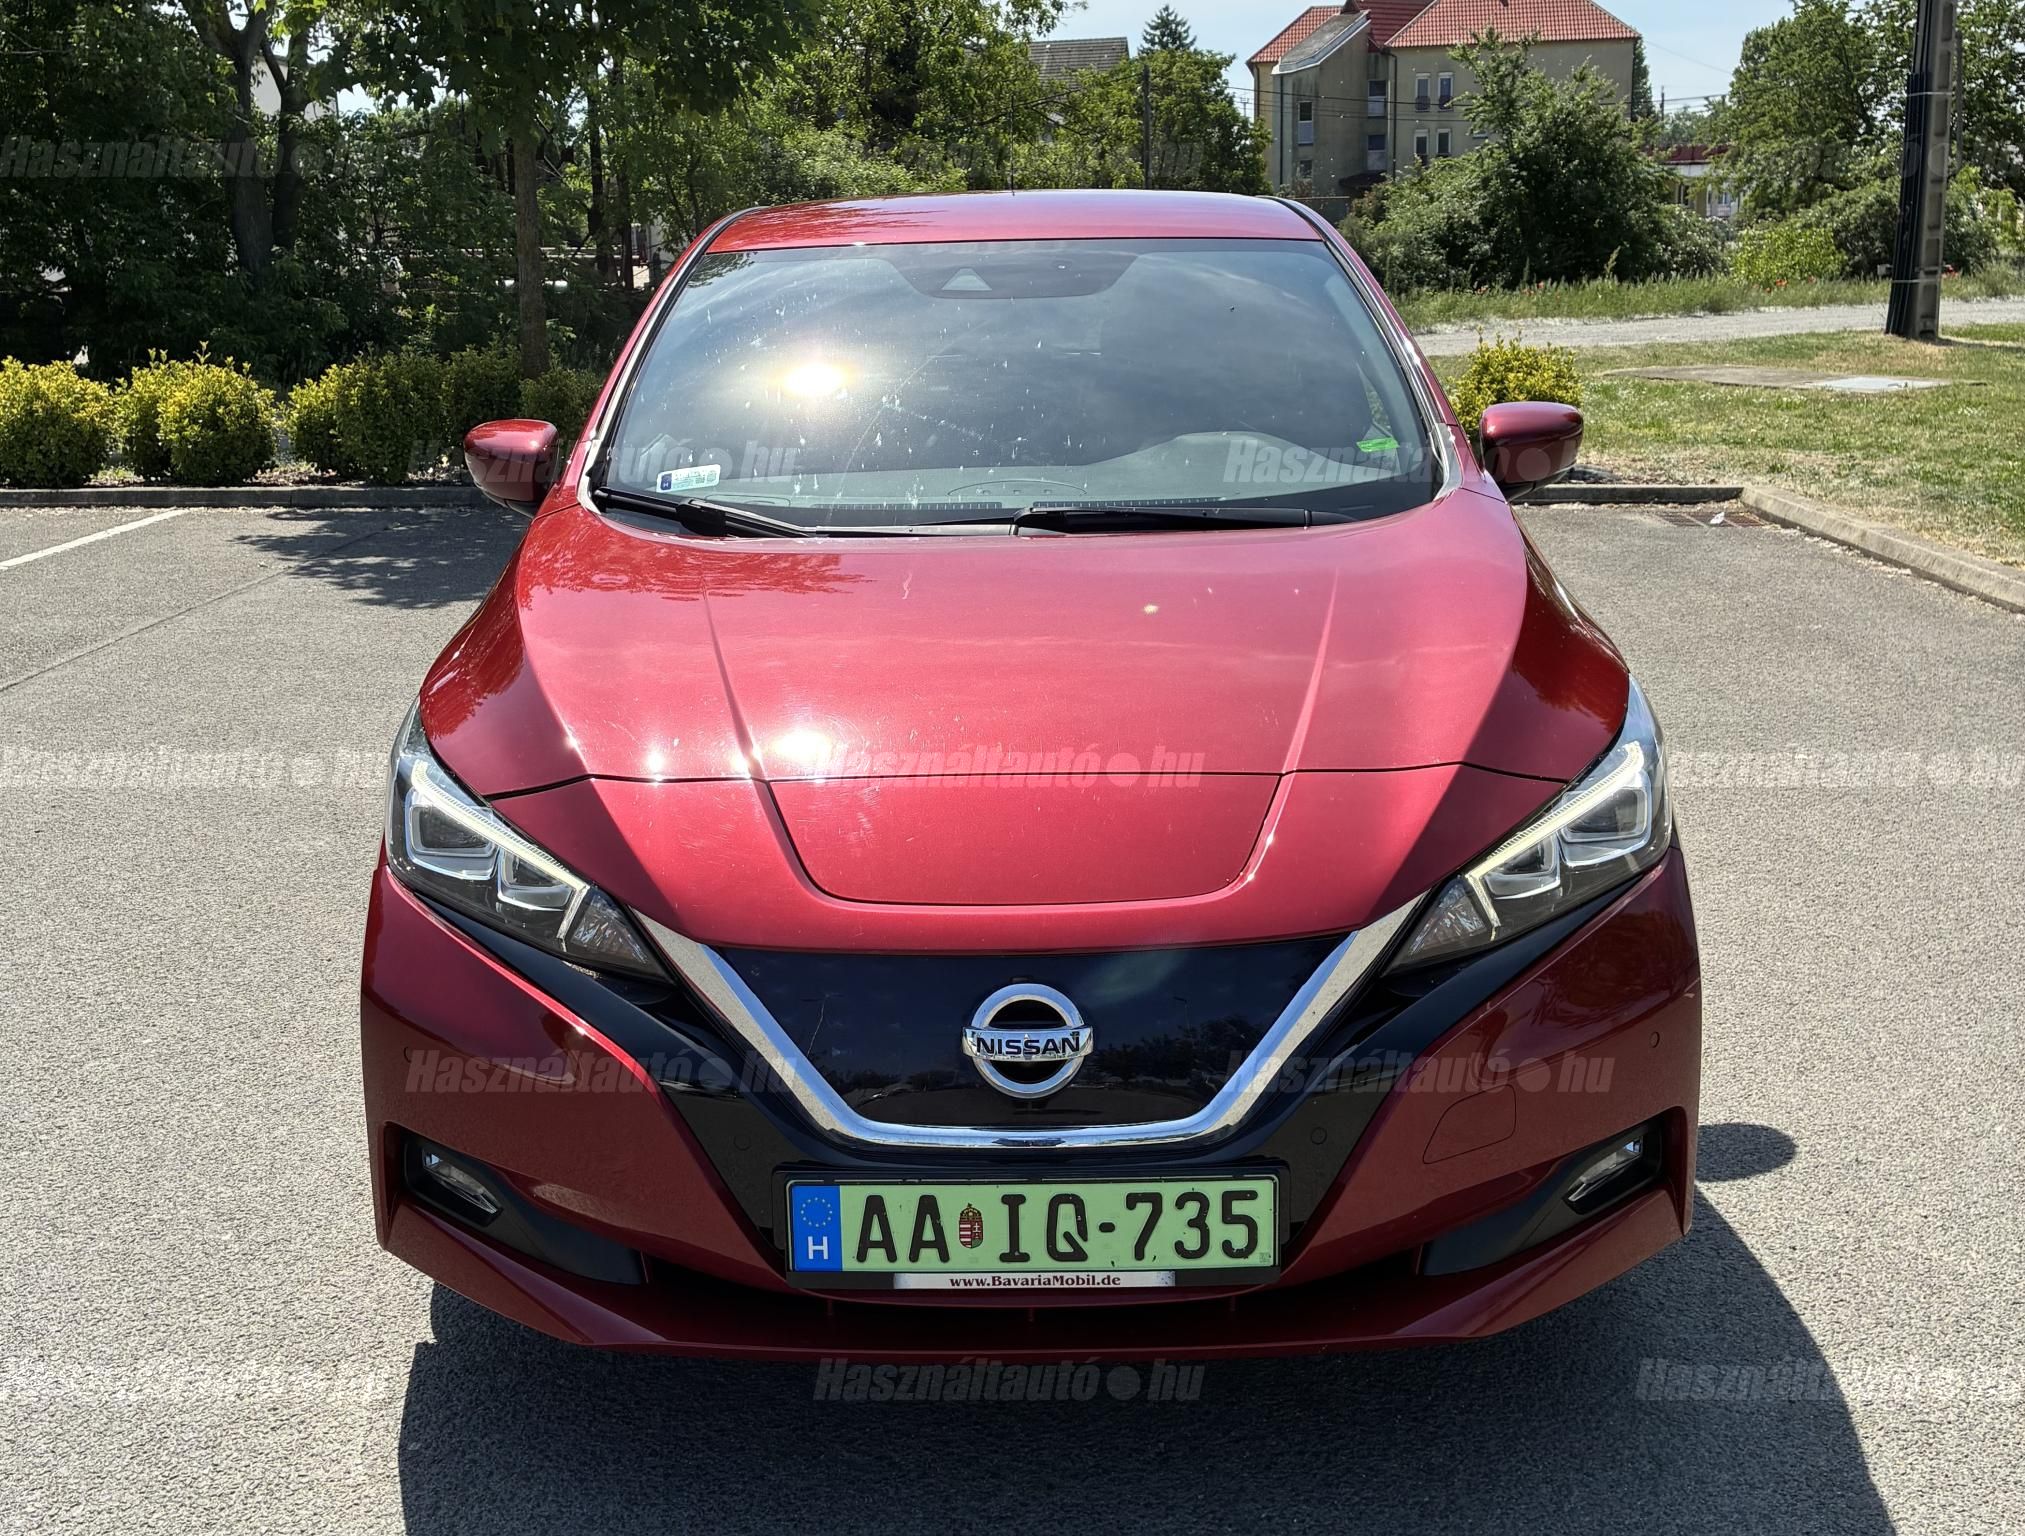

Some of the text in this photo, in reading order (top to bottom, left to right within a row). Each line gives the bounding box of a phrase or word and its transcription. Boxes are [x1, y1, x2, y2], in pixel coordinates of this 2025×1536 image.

[976, 1037, 1080, 1055] NISSAN
[856, 1189, 1258, 1263] AA IQ-735
[807, 1236, 829, 1260] H
[949, 1274, 1121, 1288] www.BavariaMobil.de
